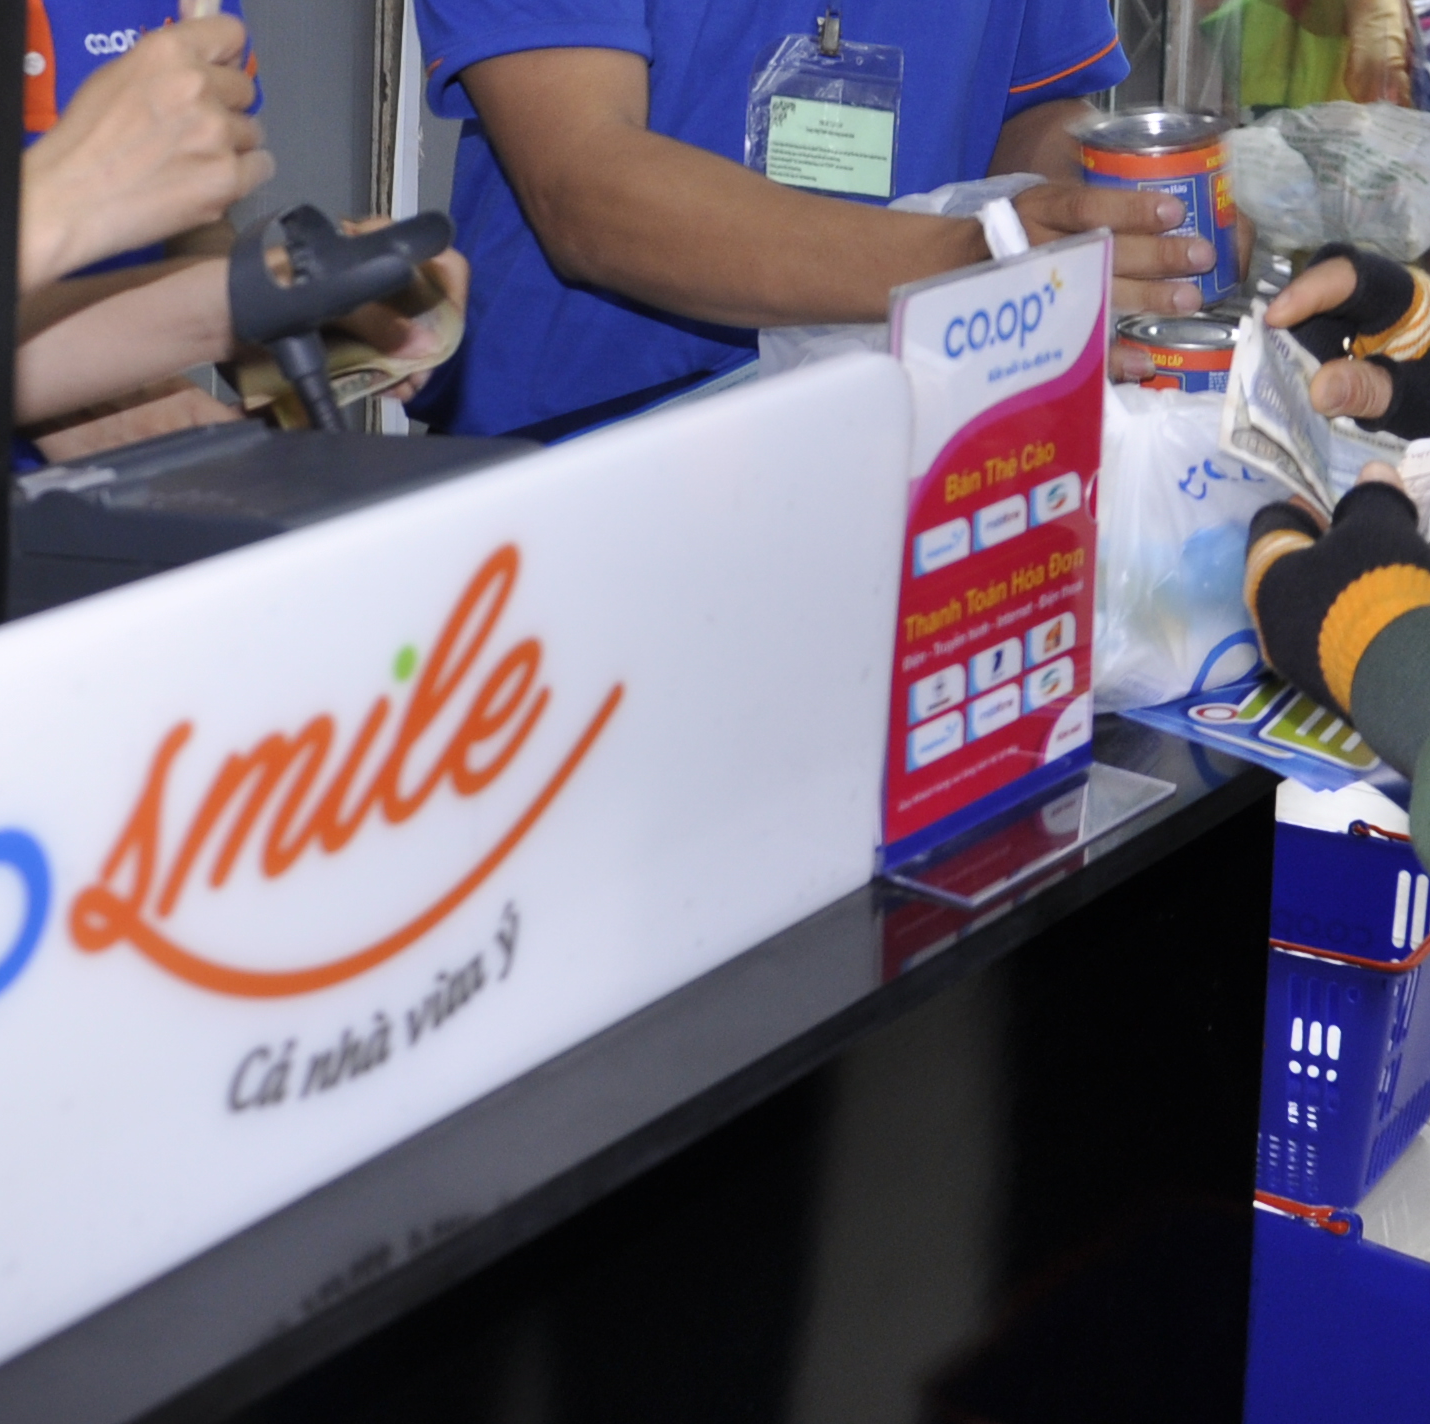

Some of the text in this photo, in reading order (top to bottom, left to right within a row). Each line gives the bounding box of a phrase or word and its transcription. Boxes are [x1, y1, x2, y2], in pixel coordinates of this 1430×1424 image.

[68, 544, 559, 968] smile
[225, 1041, 293, 1116] Cá
[299, 1000, 391, 1104] nhà
